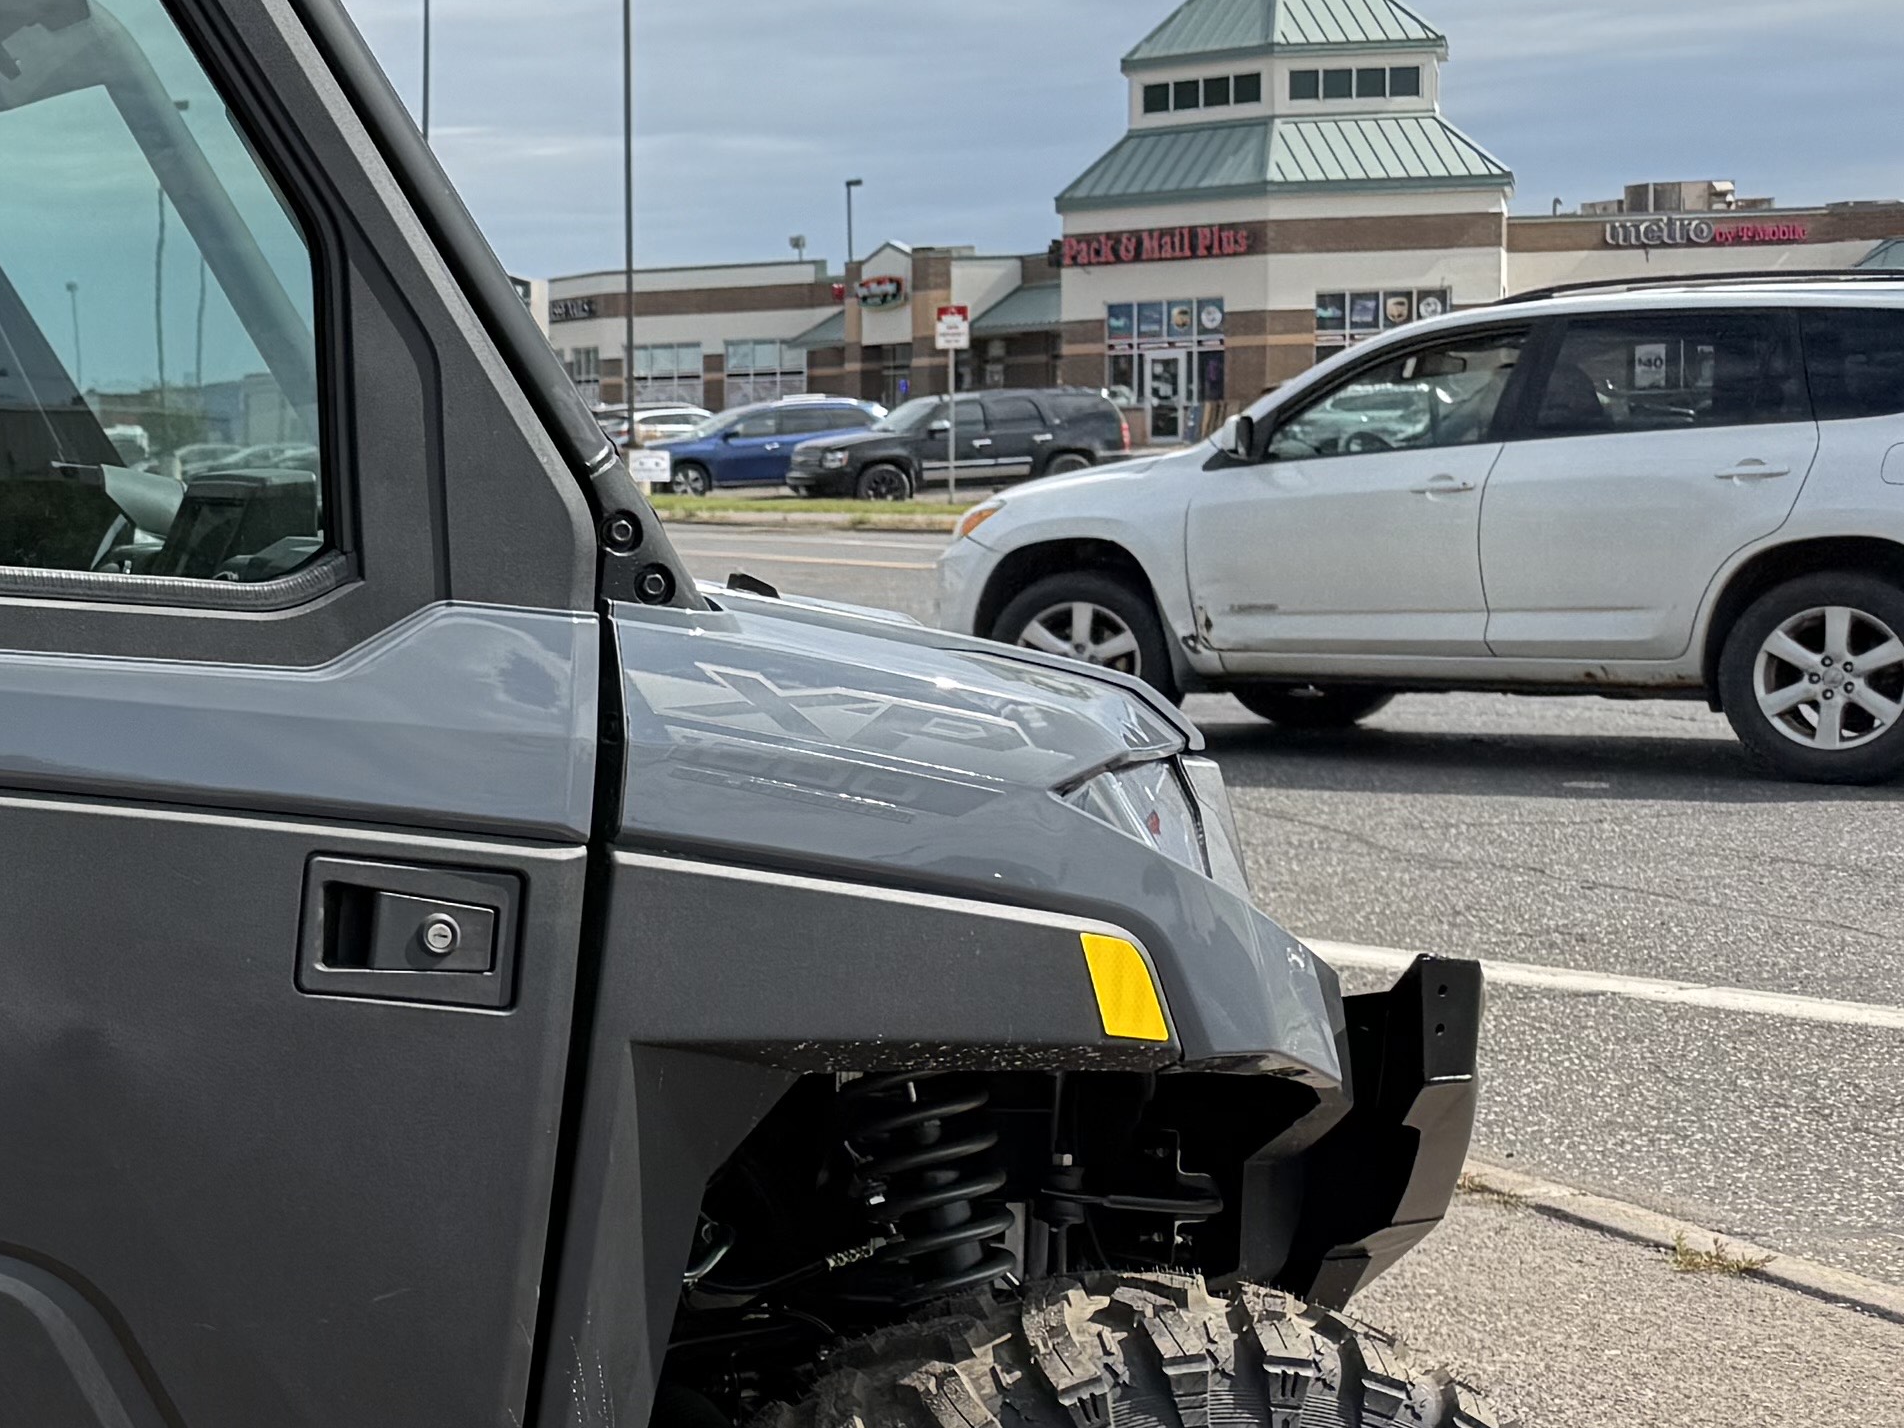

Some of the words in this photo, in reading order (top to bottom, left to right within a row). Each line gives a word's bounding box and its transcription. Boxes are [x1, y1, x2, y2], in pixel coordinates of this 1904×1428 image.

[1062, 236, 1115, 266] Pack
[1119, 233, 1137, 261] &
[1142, 227, 1192, 260] Mail
[1197, 226, 1247, 256] Plus
[1605, 217, 1713, 246] metro
